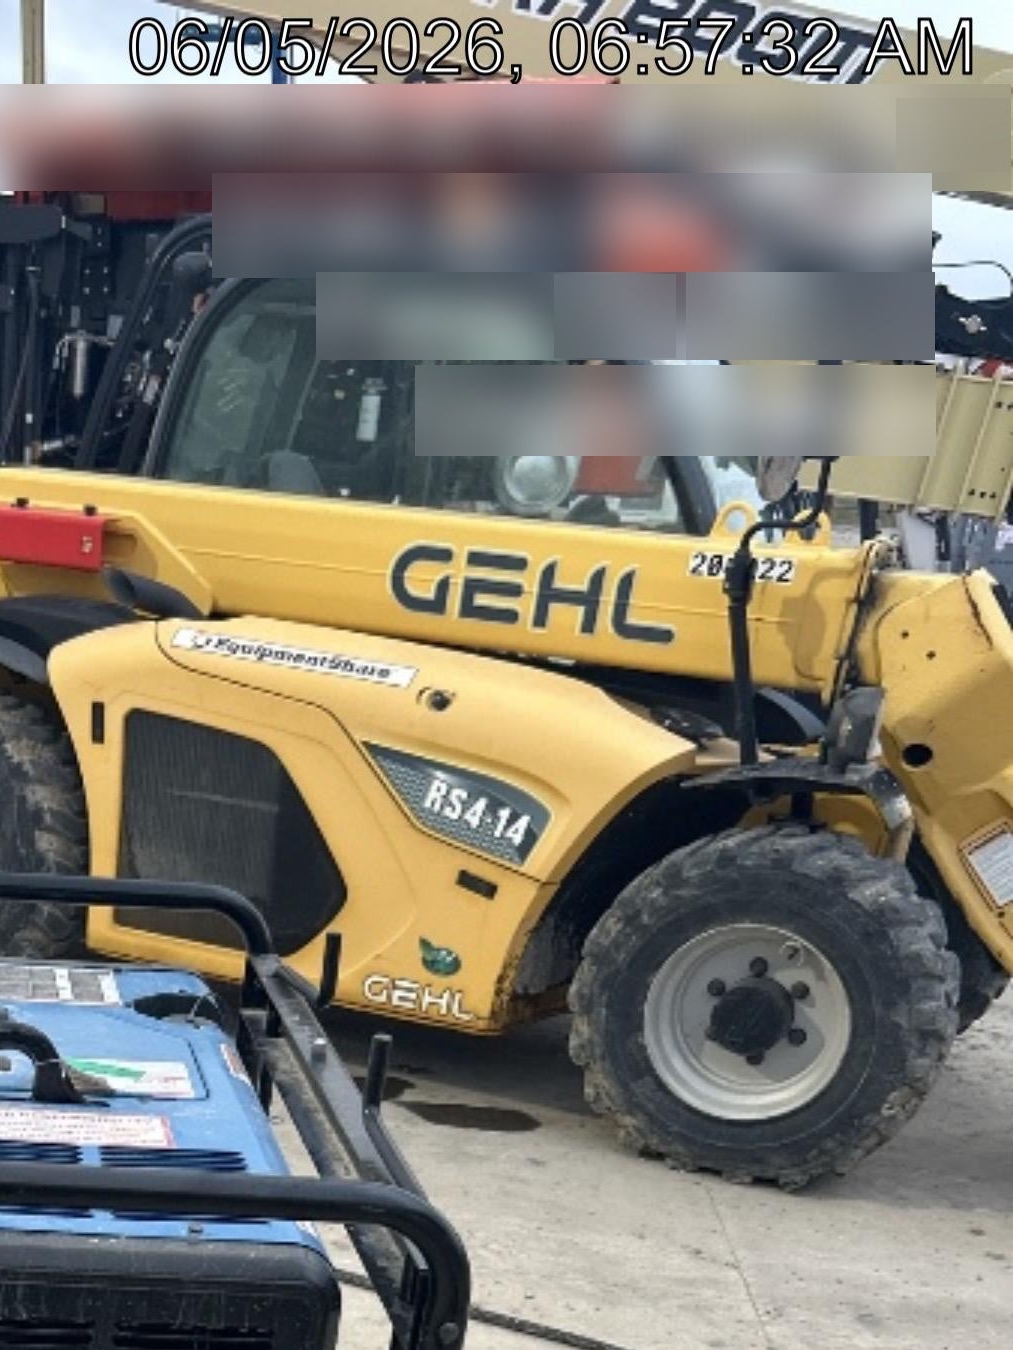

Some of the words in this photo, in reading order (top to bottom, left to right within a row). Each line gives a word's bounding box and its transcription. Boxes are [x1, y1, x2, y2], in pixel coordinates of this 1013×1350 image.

[389, 542, 675, 646] GEHL
[690, 552, 793, 583] 2022
[423, 777, 532, 847] RS4-14
[362, 974, 477, 1021] GEHL
